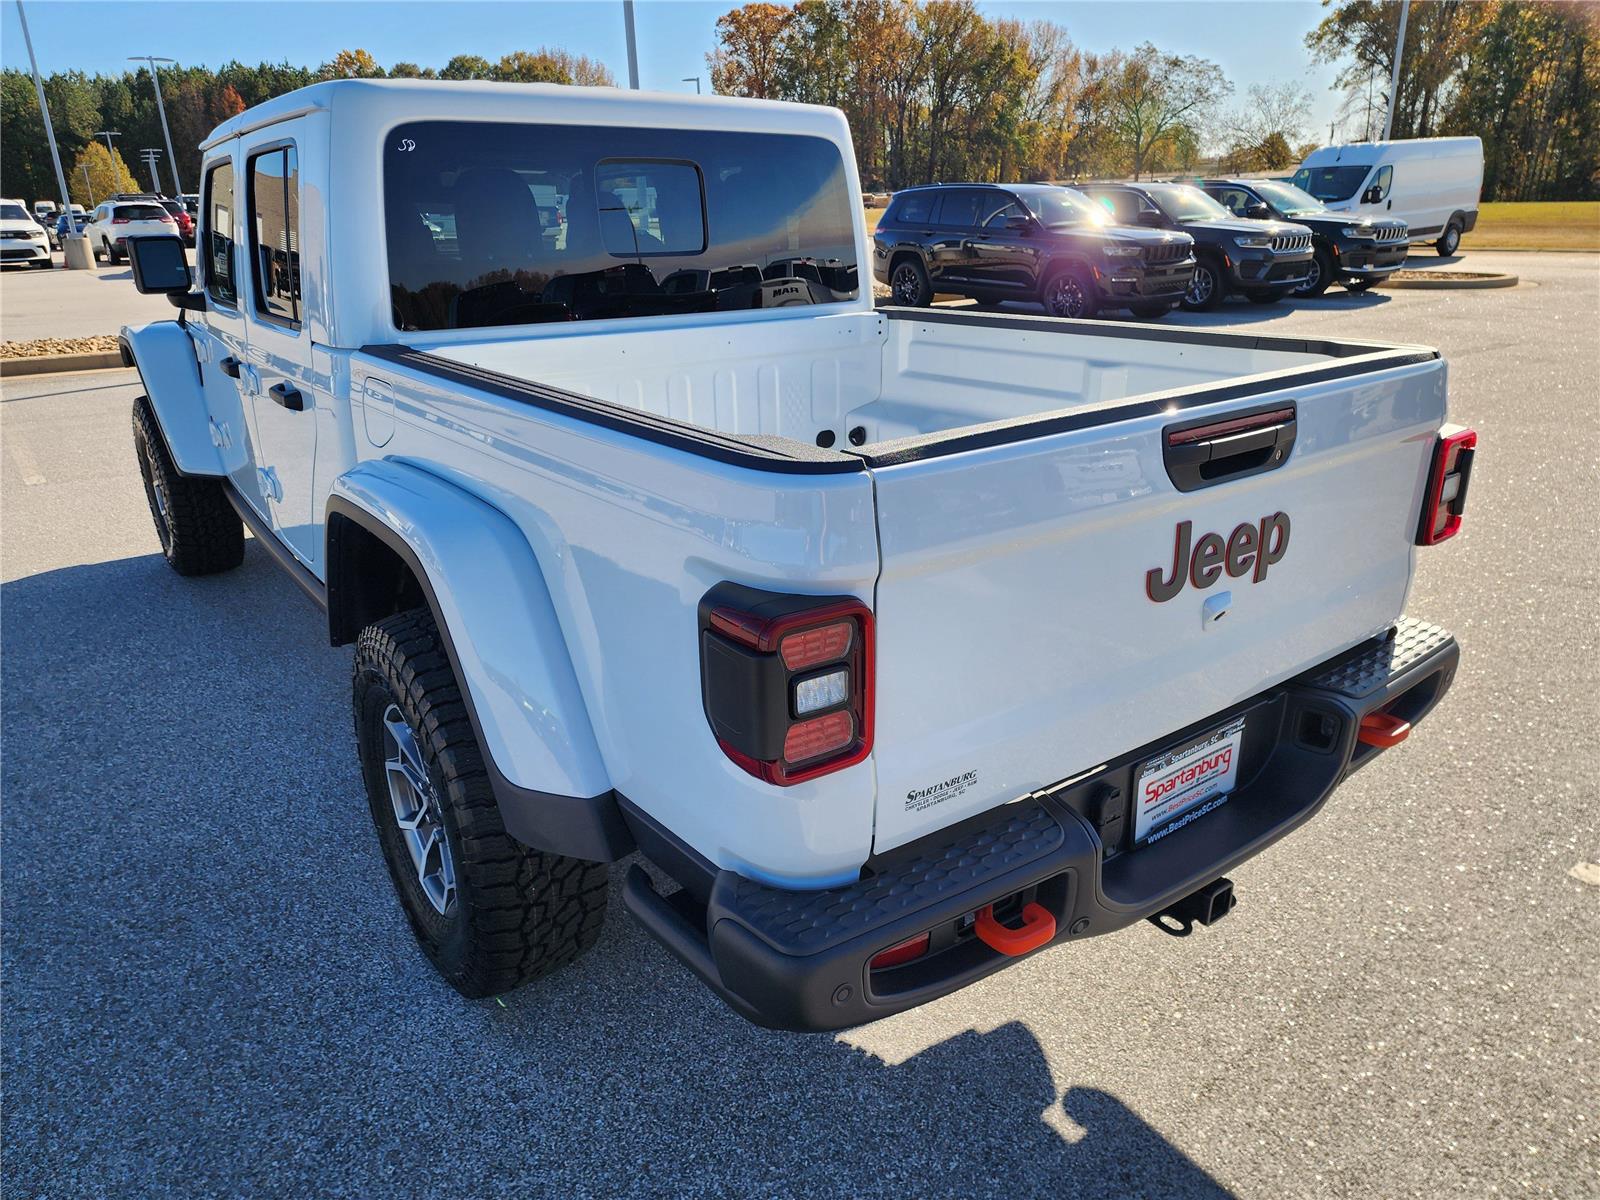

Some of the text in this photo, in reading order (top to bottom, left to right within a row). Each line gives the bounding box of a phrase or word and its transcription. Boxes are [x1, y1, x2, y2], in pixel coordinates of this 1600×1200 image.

[1145, 511, 1291, 603] Jeep
[1210, 734, 1219, 745] SC
[1144, 748, 1232, 804] Spartanburg
[1147, 795, 1228, 844] www.BestPriceSC.com
